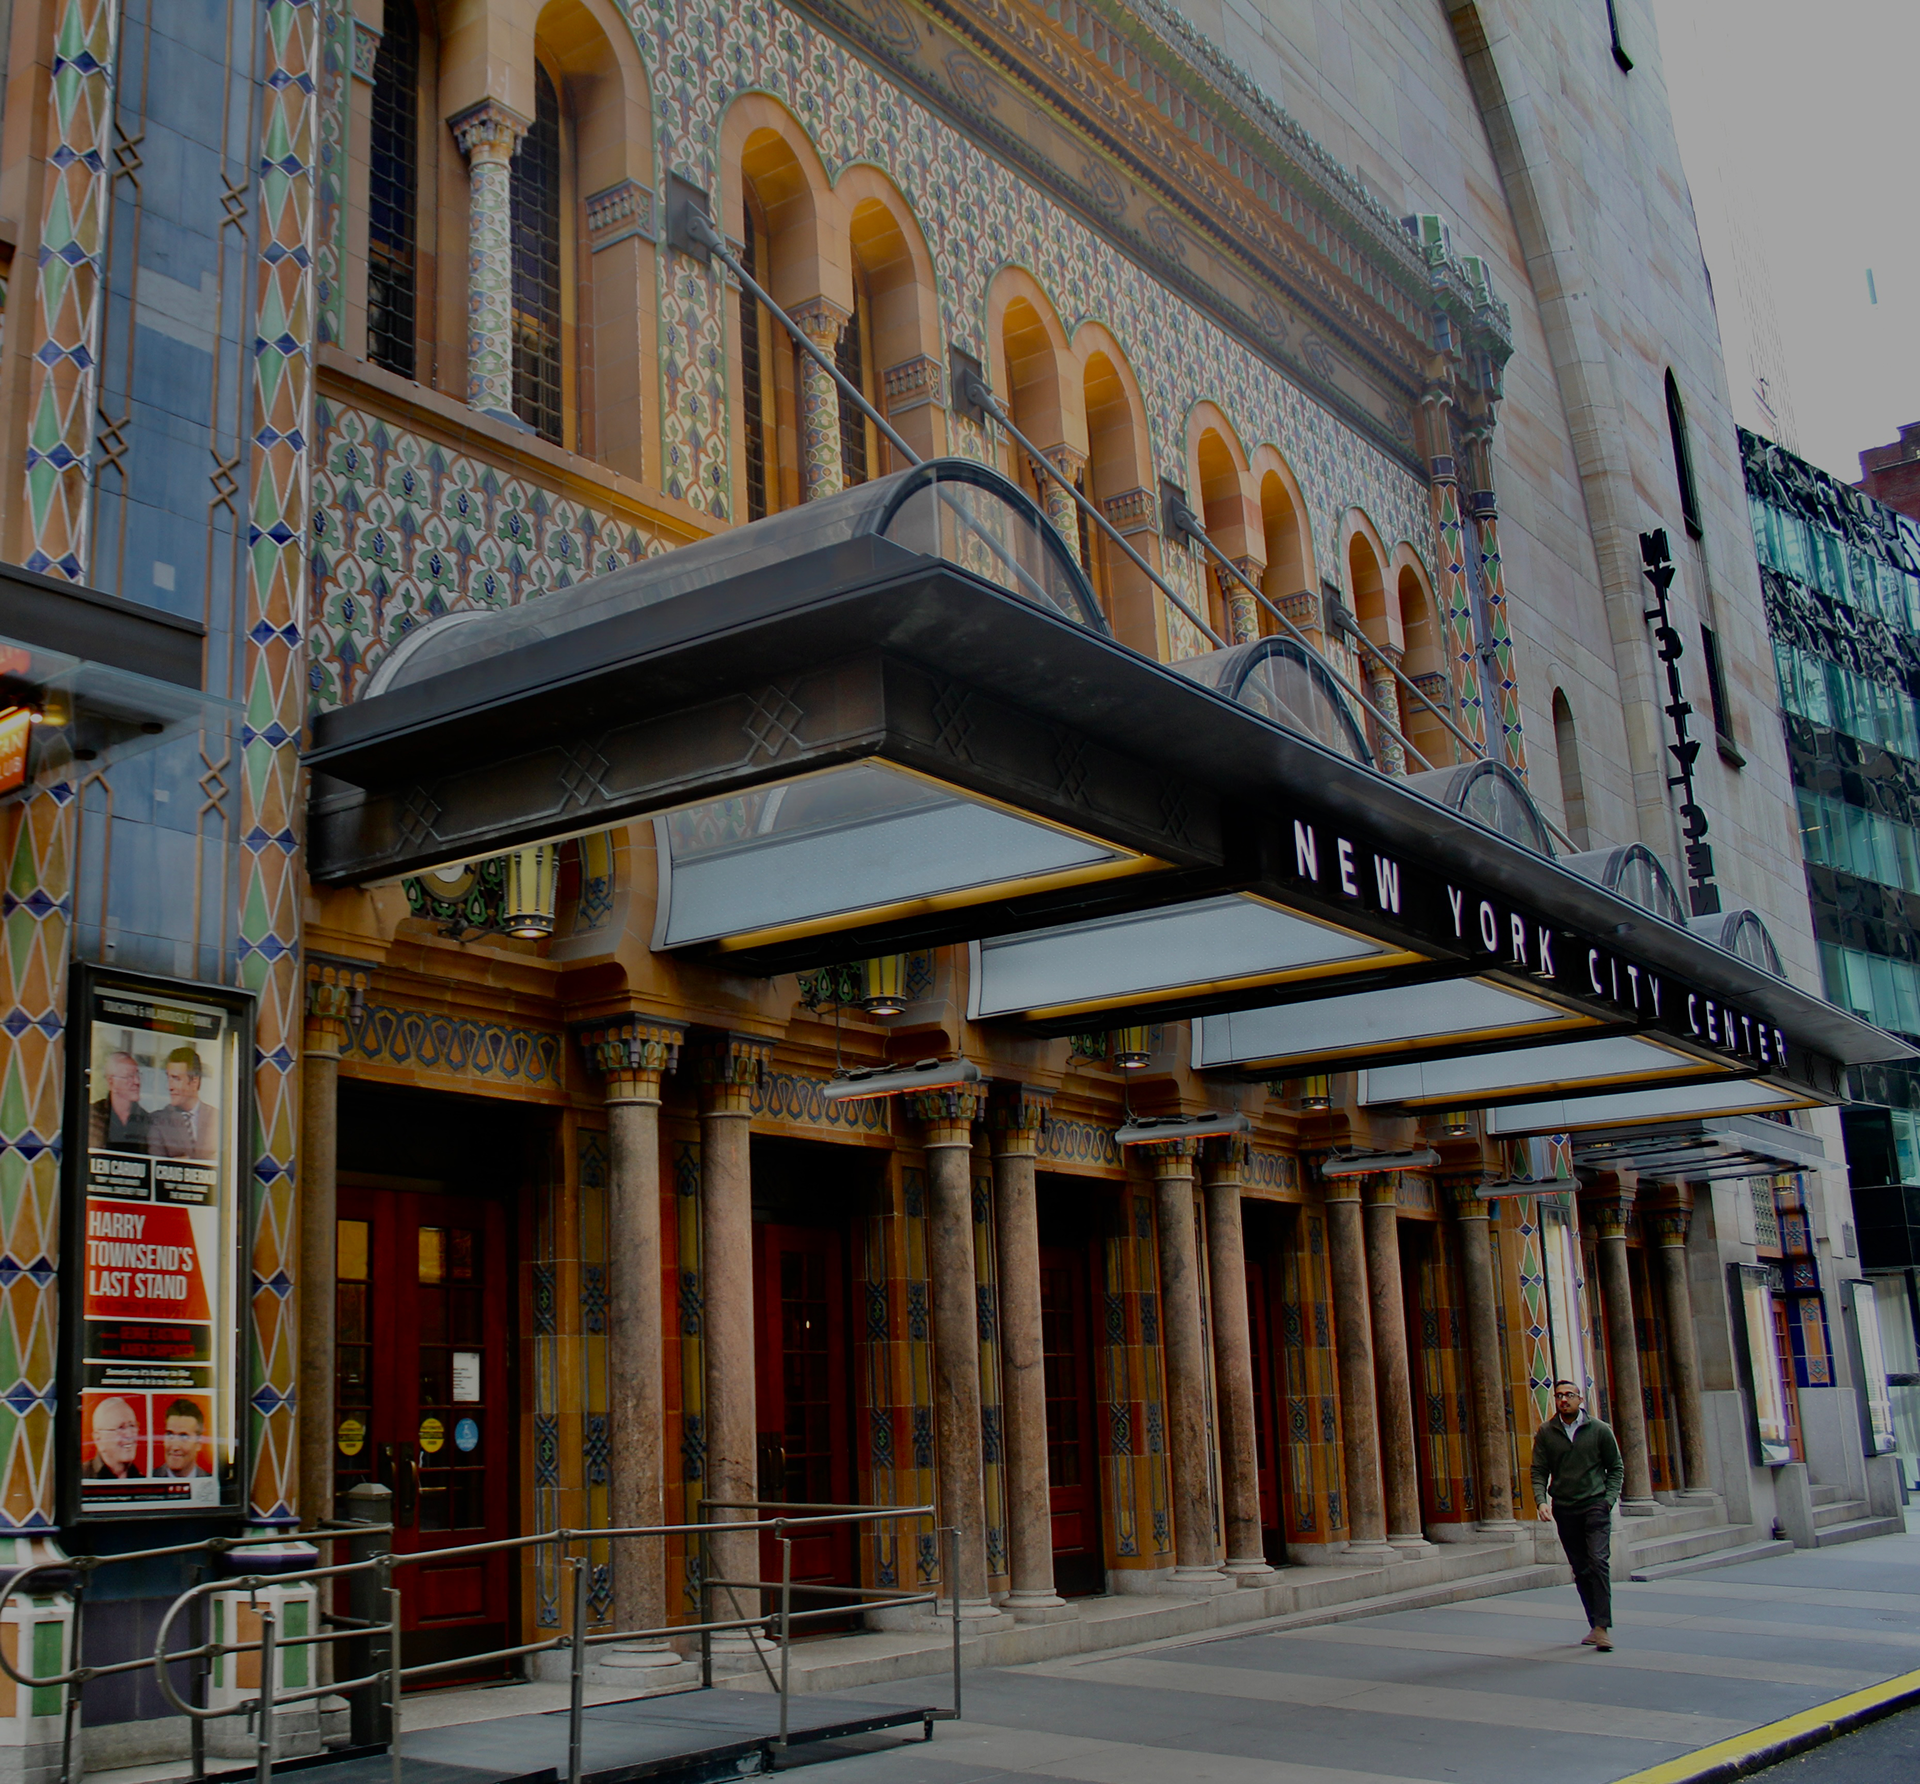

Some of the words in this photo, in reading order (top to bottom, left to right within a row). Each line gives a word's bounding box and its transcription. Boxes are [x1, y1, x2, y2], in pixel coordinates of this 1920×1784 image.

[1294, 819, 1400, 915] NEW
[1447, 884, 1555, 977] YORK
[1588, 948, 1662, 1018] CITY
[1687, 993, 1788, 1067] CENTER
[89, 1158, 111, 1175] LEN
[156, 1164, 184, 1182] CRAIG
[88, 1210, 147, 1240] HARRY
[87, 1240, 194, 1272] TOWNSEND'S
[88, 1269, 133, 1297] LAST
[133, 1272, 188, 1300] STAND
